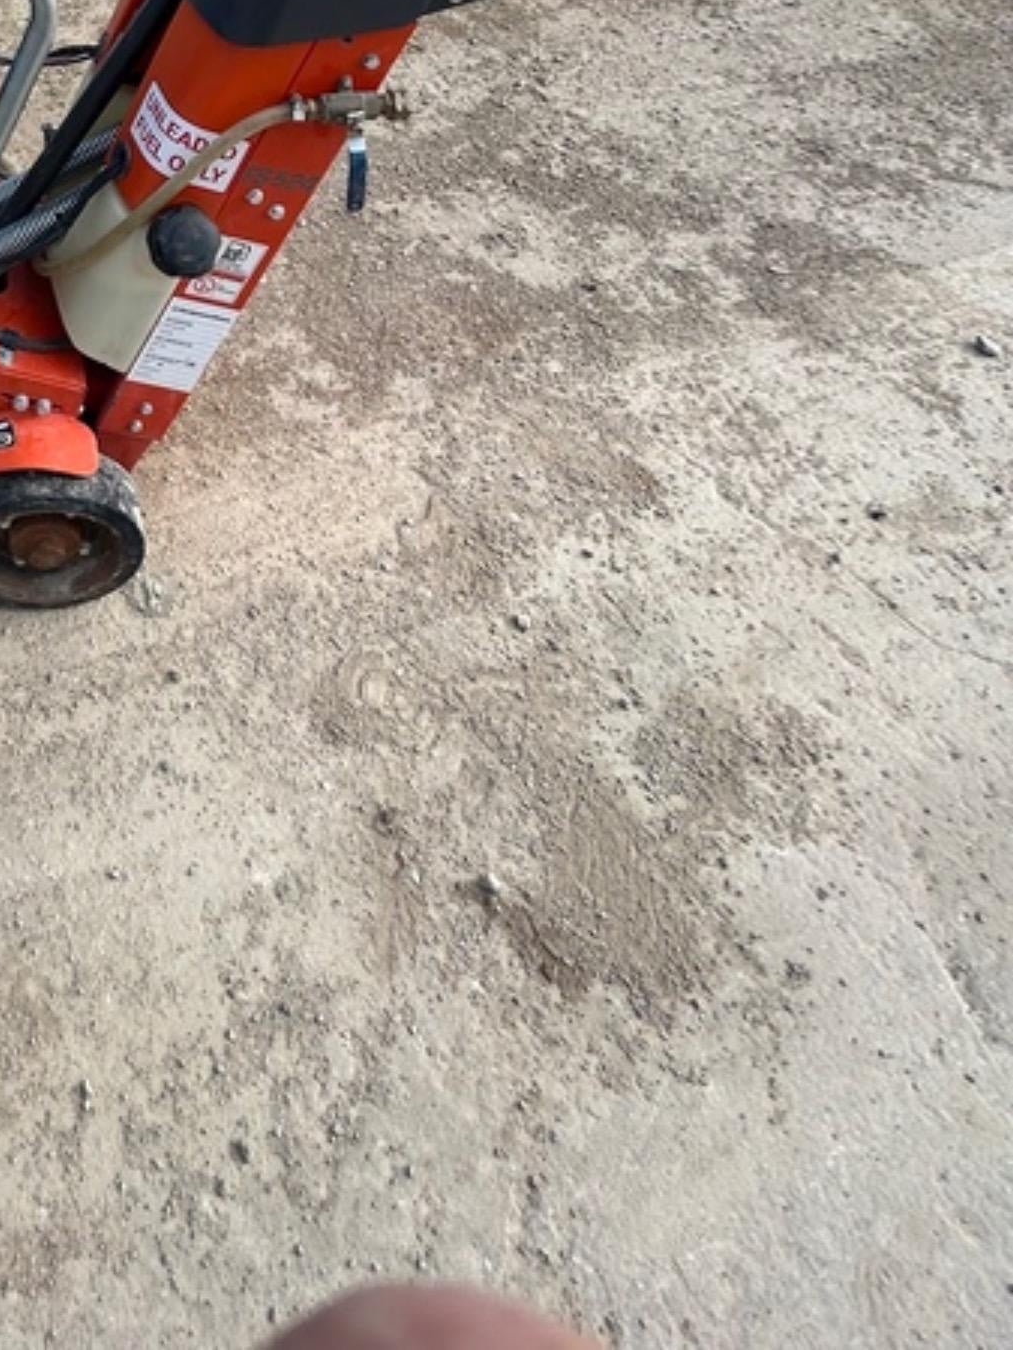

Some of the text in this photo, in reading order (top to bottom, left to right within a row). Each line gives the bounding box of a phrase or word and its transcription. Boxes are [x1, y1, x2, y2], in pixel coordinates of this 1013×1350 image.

[136, 117, 163, 163] FUEL
[169, 154, 228, 182] OLY
[145, 91, 237, 161] UNLEADD
